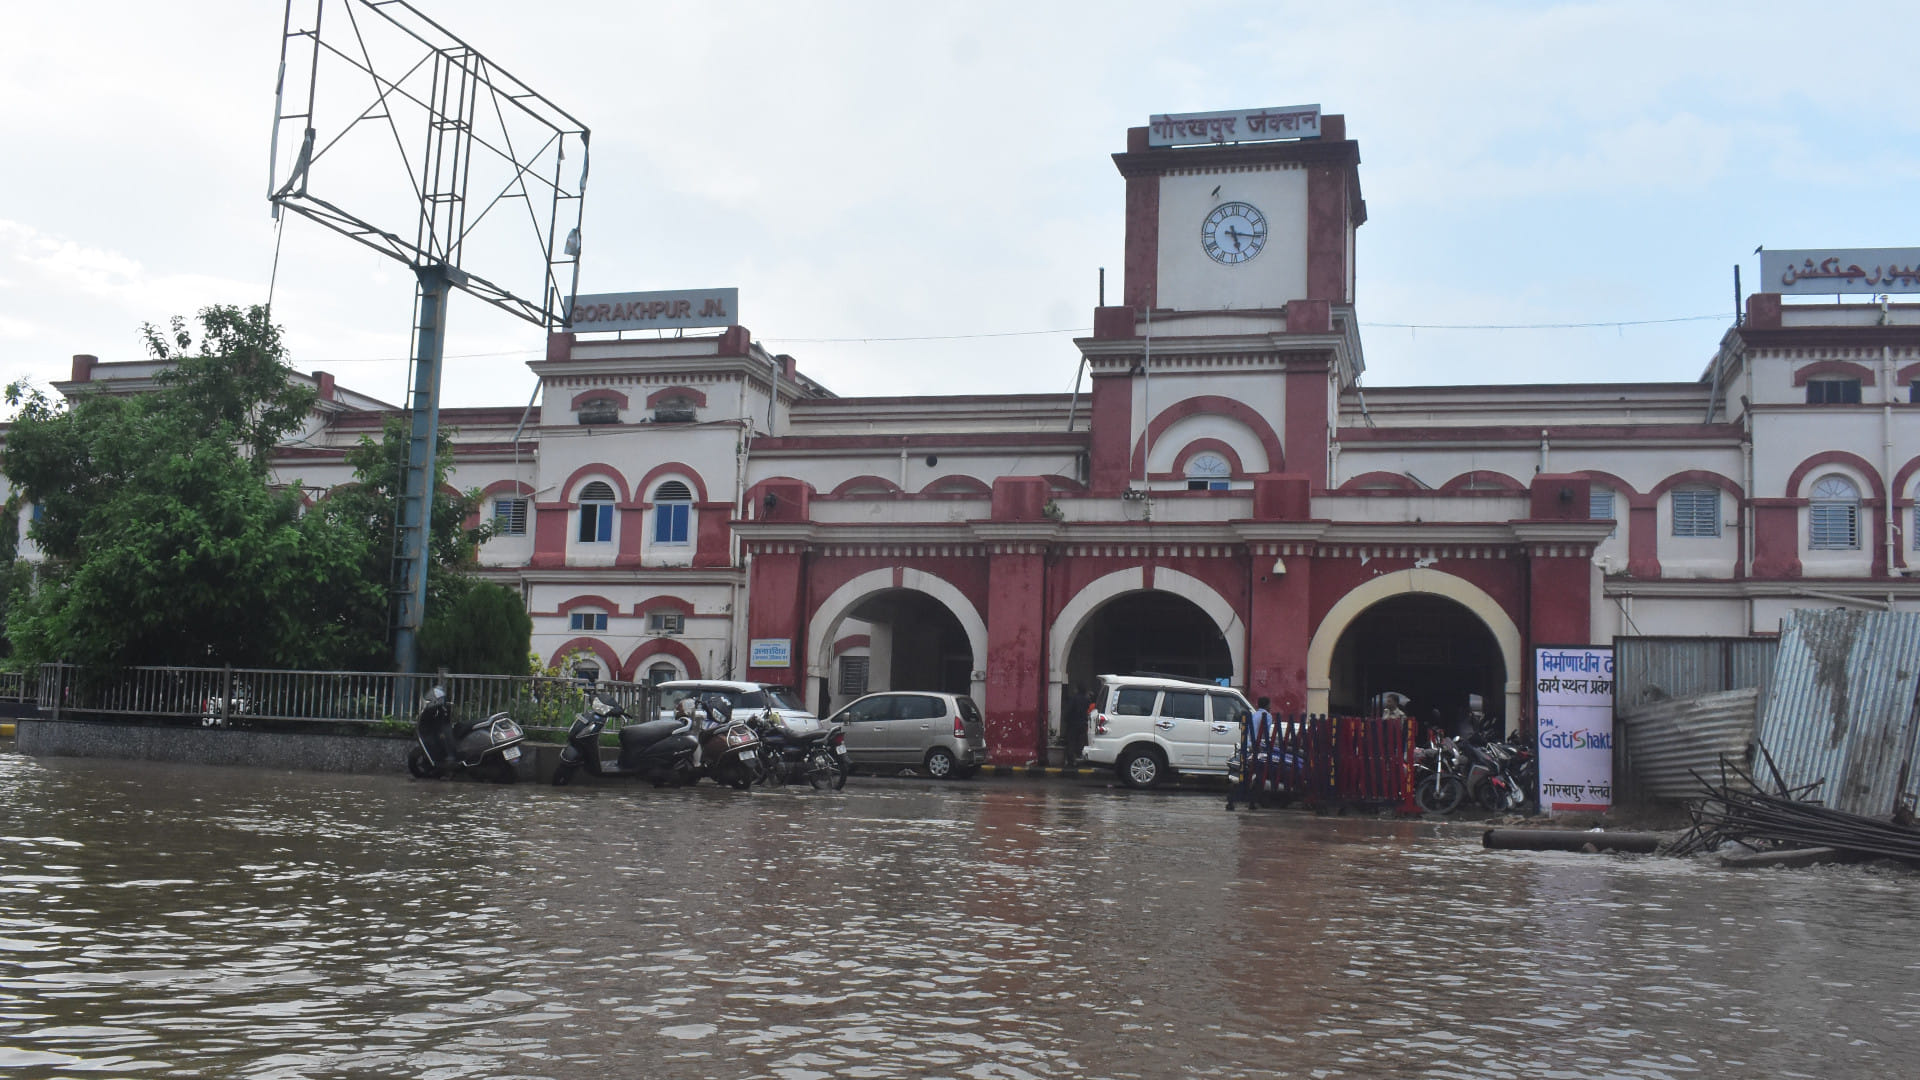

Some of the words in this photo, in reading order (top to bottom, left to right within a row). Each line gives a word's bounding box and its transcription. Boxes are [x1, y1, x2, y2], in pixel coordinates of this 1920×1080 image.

[1152, 114, 1237, 142] गोरखपुर
[1246, 111, 1318, 133] जंक्शन
[572, 300, 692, 324] GORAKHPUR
[698, 298, 727, 318] JN.
[1541, 651, 1600, 673] निर्माणाधीन
[1538, 676, 1560, 693] कार्य
[1540, 728, 1613, 750] GatiShakt
[1543, 778, 1585, 802] गोरखपुर
